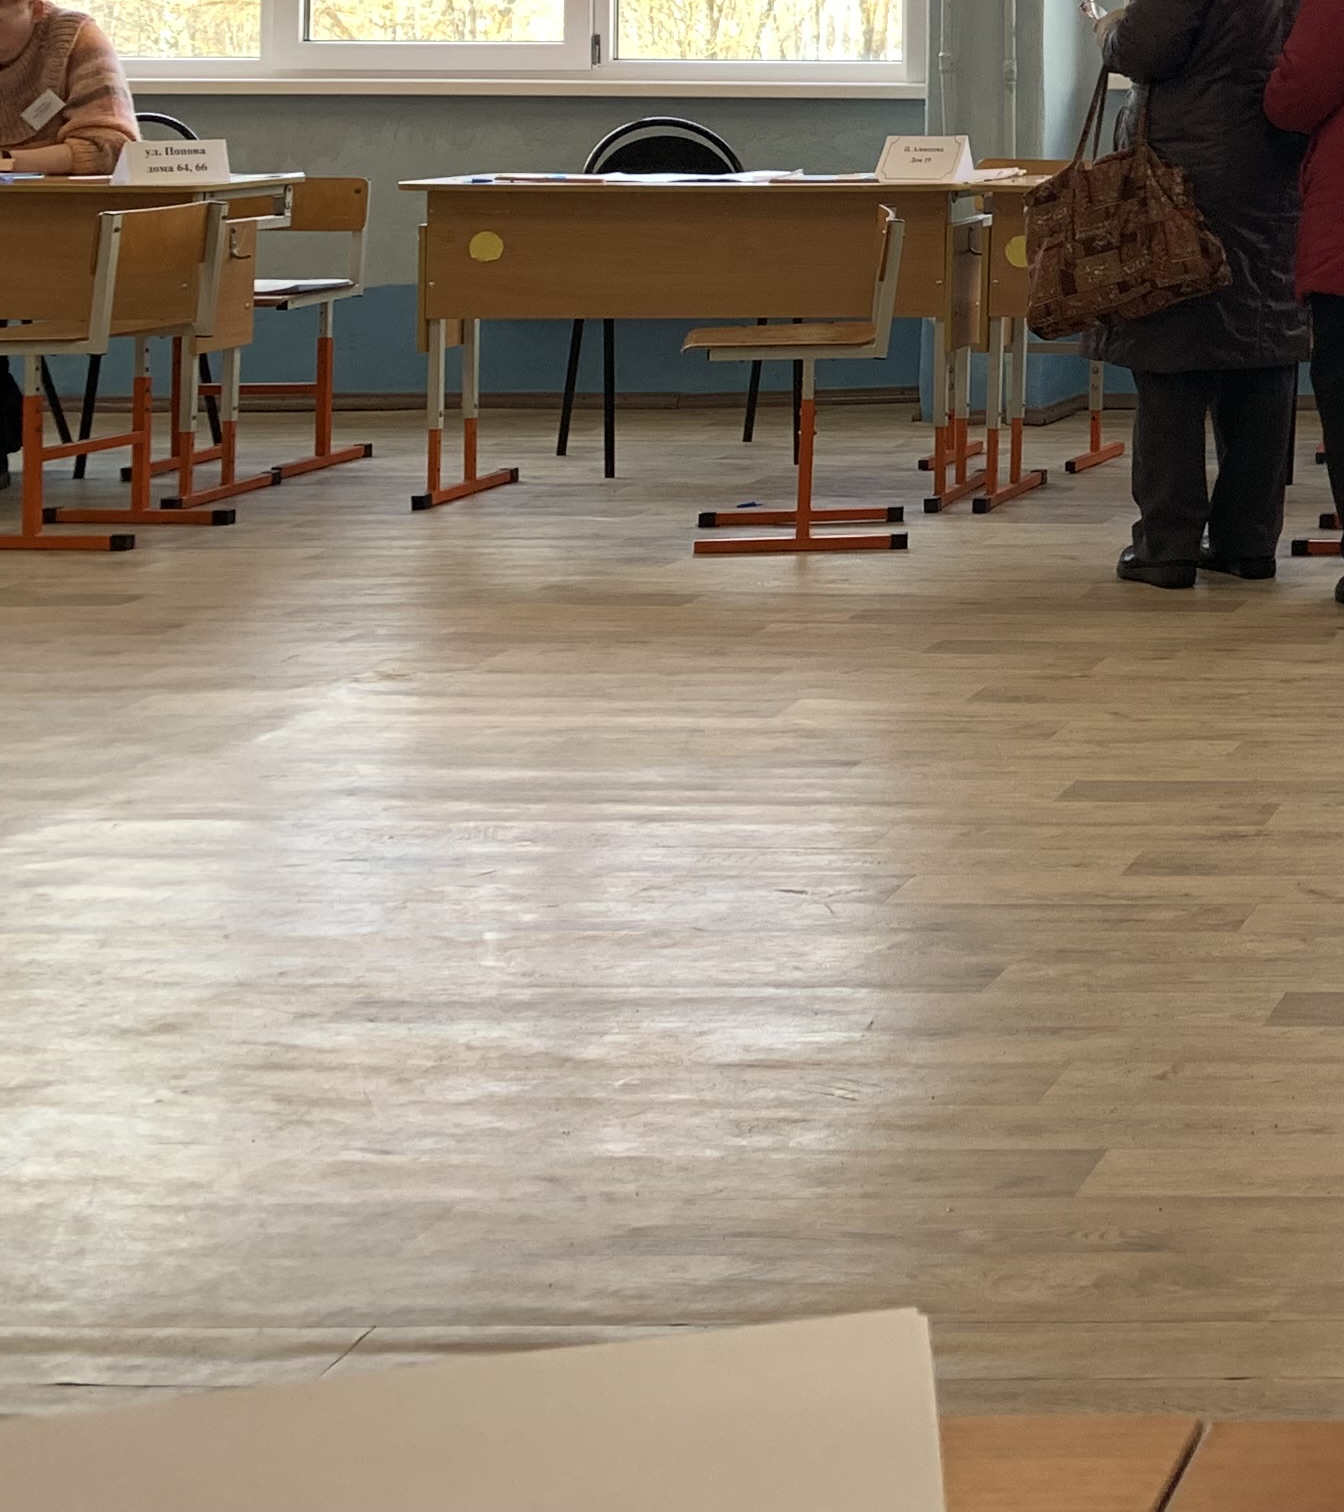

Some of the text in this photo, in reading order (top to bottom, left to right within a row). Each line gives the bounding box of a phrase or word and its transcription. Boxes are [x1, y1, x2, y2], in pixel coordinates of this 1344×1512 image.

[144, 146, 206, 158] ул. Попова
[176, 163, 192, 172] 64,
[195, 162, 208, 172] 66
